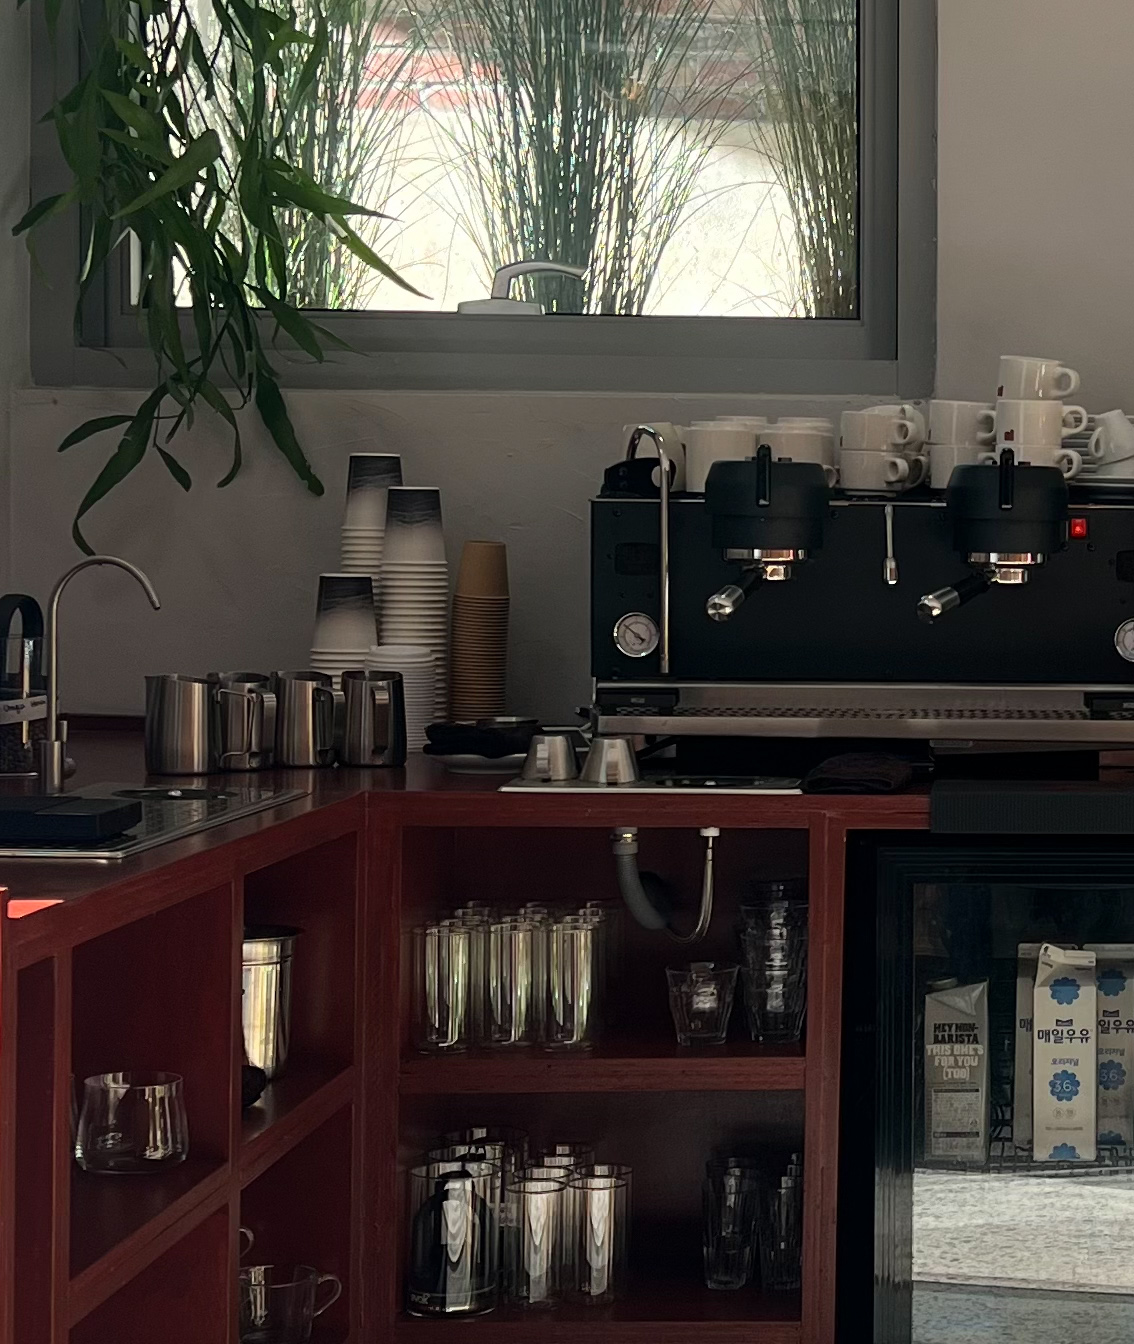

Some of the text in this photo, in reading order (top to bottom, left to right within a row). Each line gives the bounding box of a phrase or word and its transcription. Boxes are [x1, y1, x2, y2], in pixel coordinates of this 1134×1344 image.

[933, 1033, 979, 1044] BARISTA
[1037, 1028, 1091, 1044] 매일우유
[926, 1044, 951, 1056] THIS
[935, 1056, 979, 1066] FOR YOU
